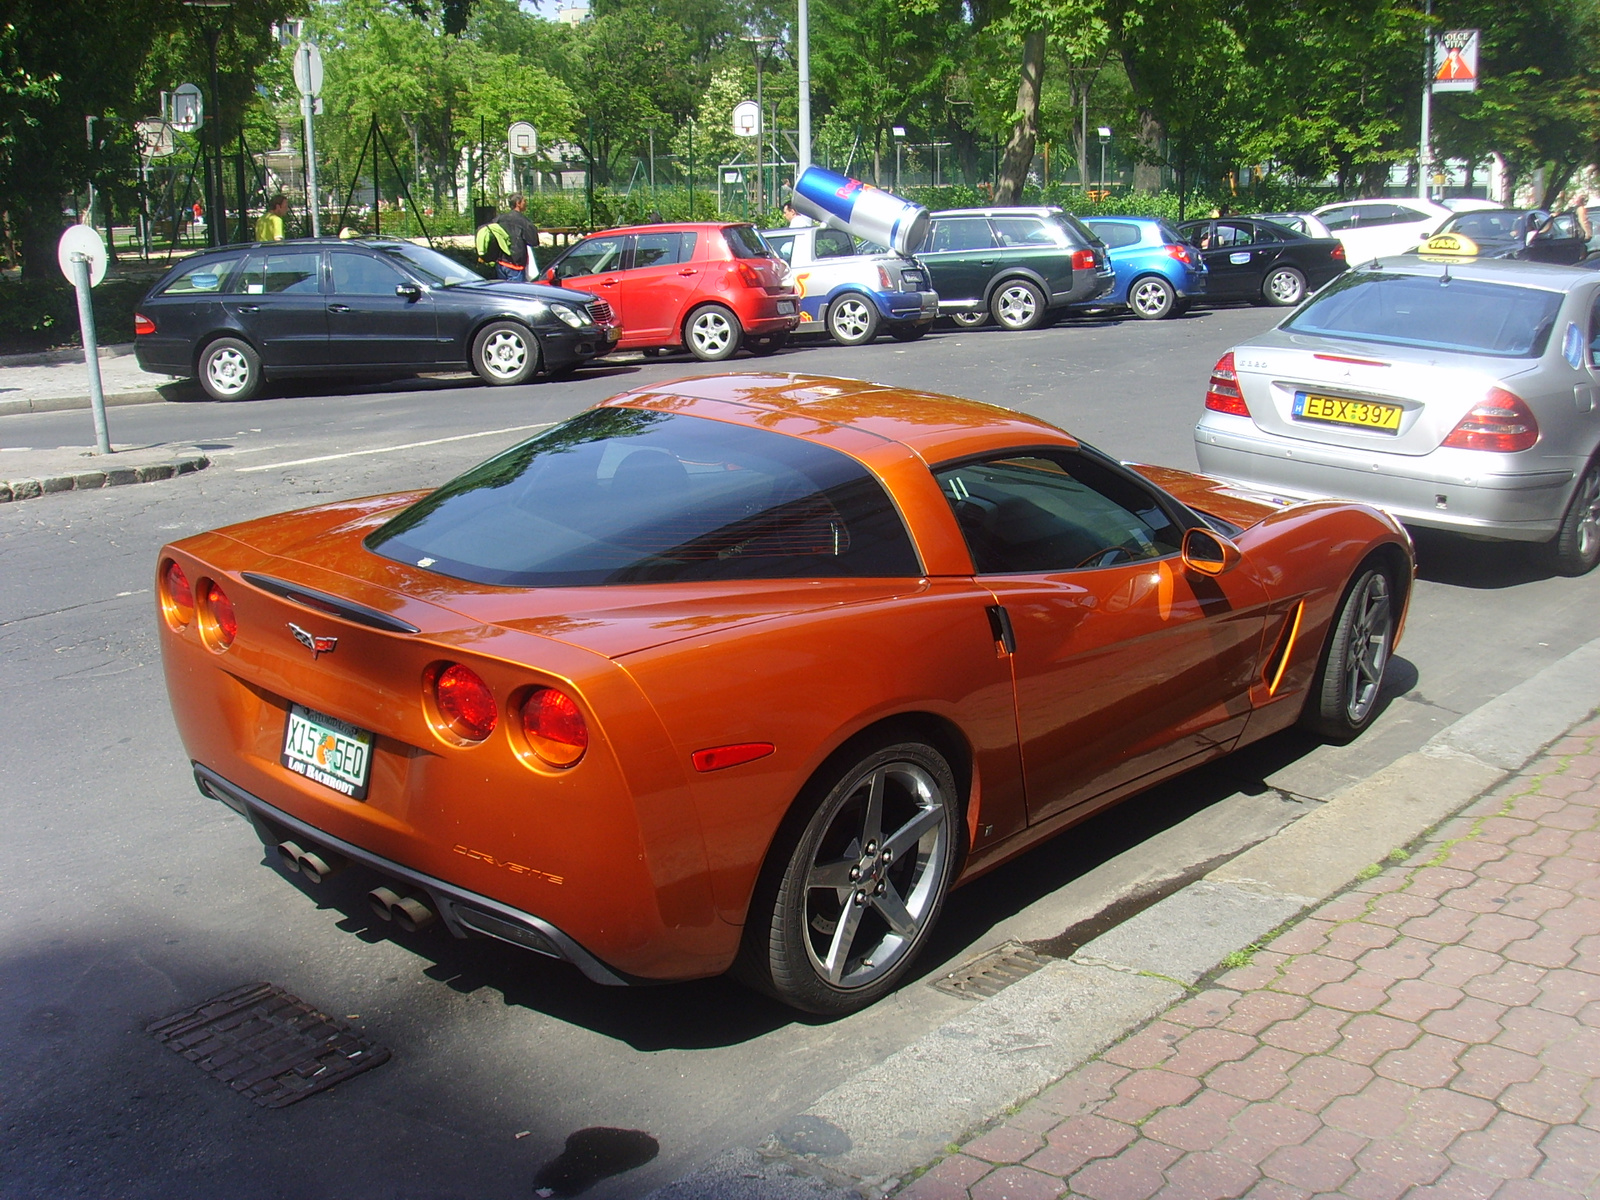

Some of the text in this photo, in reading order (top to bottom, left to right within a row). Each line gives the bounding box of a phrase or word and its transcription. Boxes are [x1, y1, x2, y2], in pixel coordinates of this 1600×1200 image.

[1441, 33, 1469, 41] DOLCE
[1445, 40, 1464, 48] VITA
[835, 178, 862, 199] Red
[1295, 404, 1303, 413] H
[1307, 397, 1395, 425] EBX-397
[288, 718, 317, 759] X15
[334, 737, 364, 779] 5EQ
[306, 765, 355, 795] BACHRODT
[453, 844, 564, 885] CORVETTE
